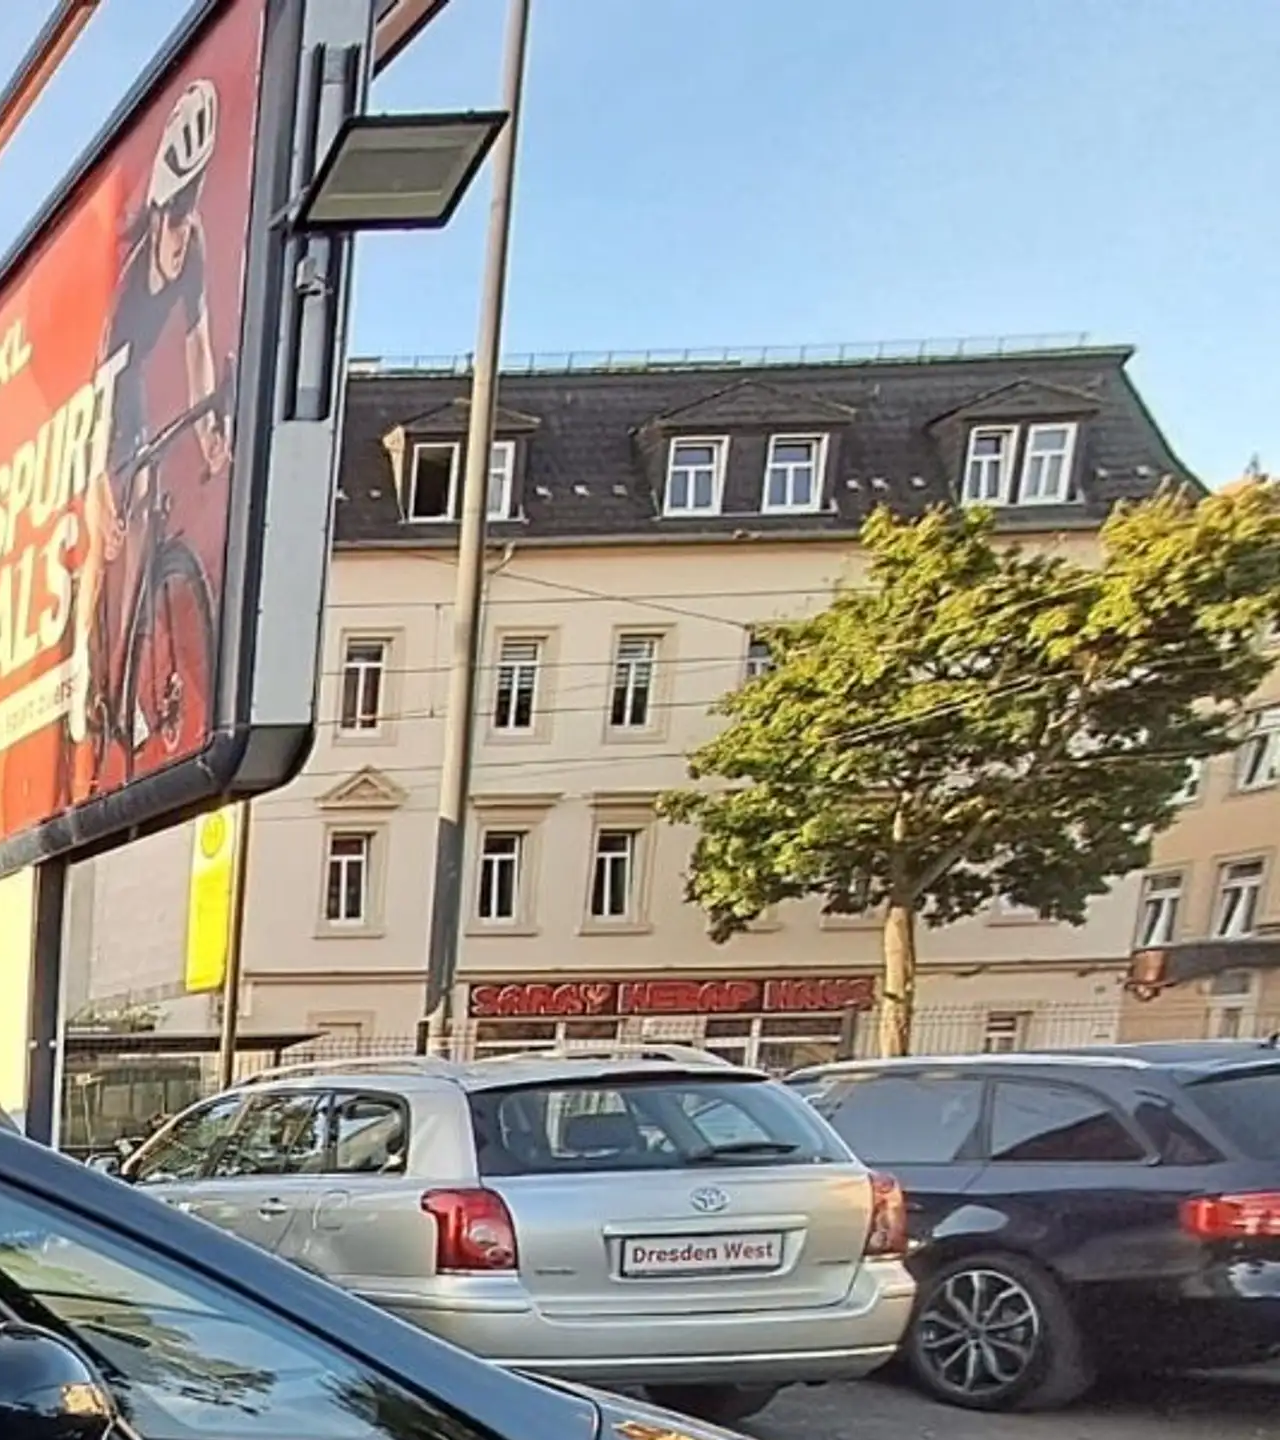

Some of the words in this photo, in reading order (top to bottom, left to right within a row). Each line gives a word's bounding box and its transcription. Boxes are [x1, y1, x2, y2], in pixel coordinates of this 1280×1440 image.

[472, 983, 612, 1015] SARAY
[618, 982, 760, 1014] KEBAP
[632, 1244, 717, 1263] Dresden
[724, 1242, 774, 1259] West
